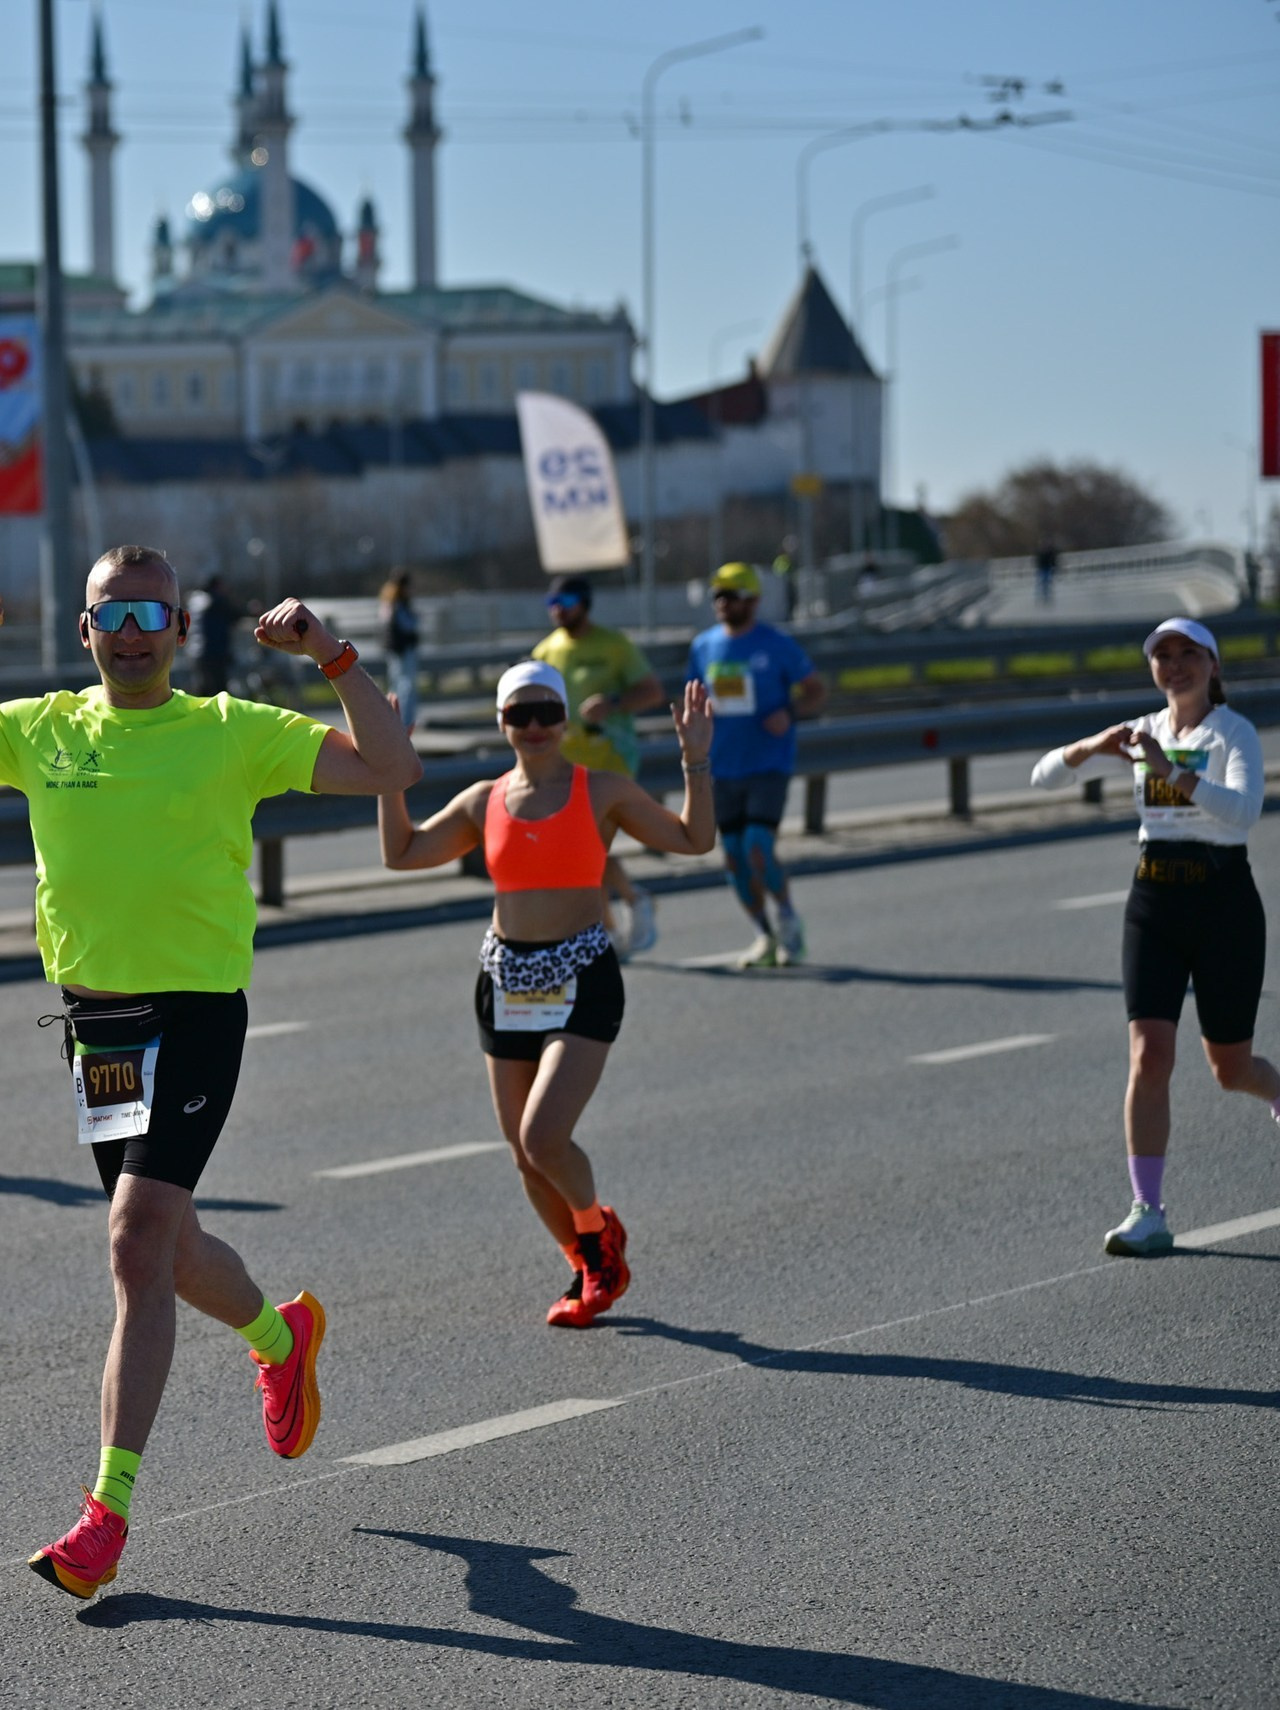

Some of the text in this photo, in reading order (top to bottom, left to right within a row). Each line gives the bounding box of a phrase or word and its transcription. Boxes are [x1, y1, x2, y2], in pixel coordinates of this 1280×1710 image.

[46, 781, 59, 789] MORE
[76, 1077, 83, 1093] B
[89, 1061, 135, 1095] 9770
